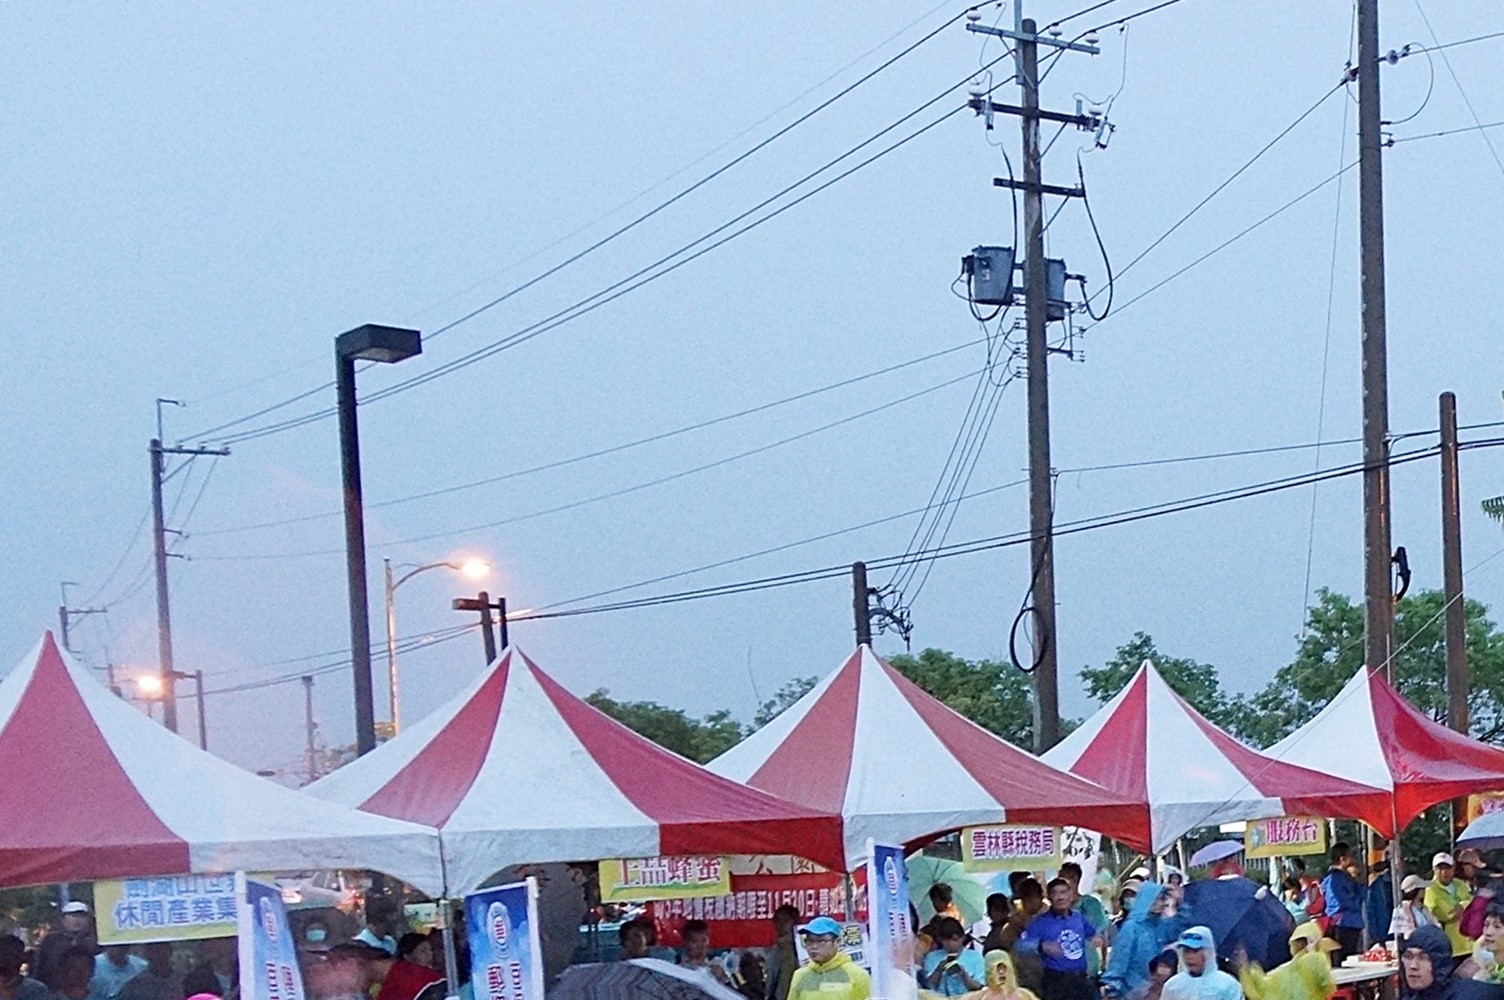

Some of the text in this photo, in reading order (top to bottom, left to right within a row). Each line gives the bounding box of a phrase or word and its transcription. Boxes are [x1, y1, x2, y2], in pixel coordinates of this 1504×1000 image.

[972, 827, 1055, 860] 雲林縣稅務局
[1265, 818, 1320, 845] 服務台
[614, 856, 722, 888] 上品蜂蜜
[124, 876, 236, 898] 劍湖山世
